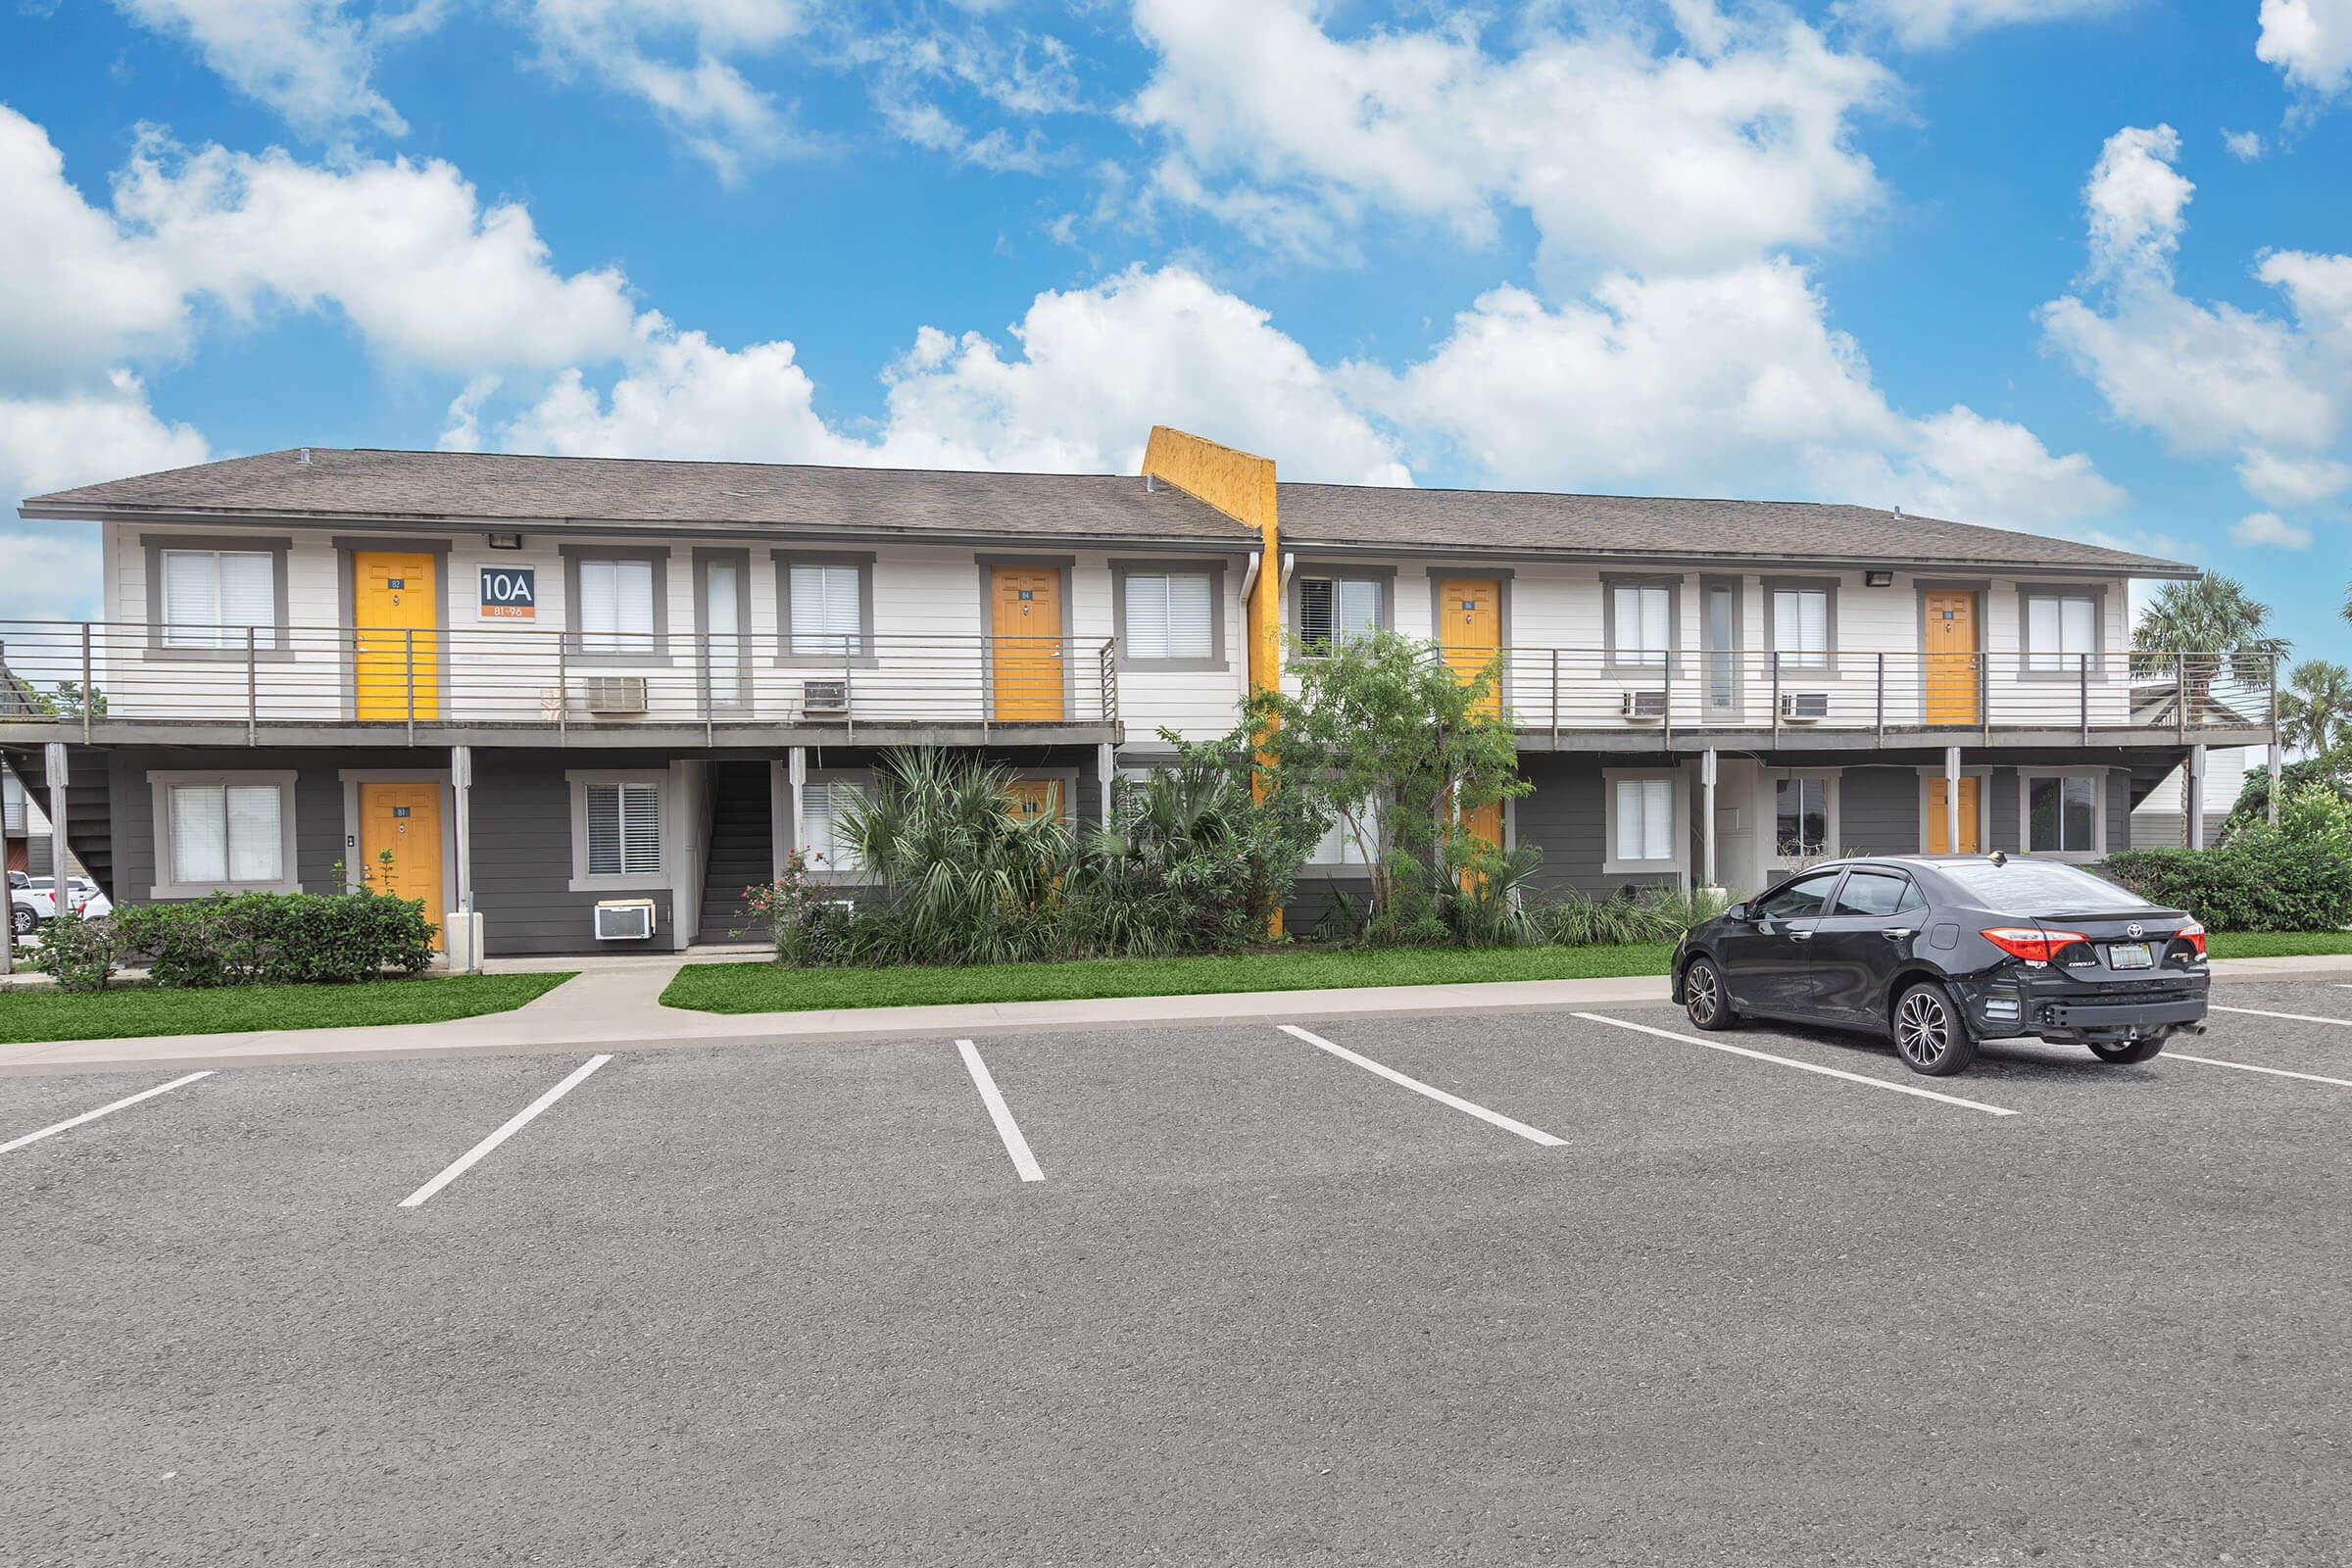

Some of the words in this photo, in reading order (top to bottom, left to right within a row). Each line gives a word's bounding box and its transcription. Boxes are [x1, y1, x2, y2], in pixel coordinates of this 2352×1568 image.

[391, 579, 401, 588] 82
[482, 573, 532, 601] 10A
[494, 607, 523, 616] 81-96
